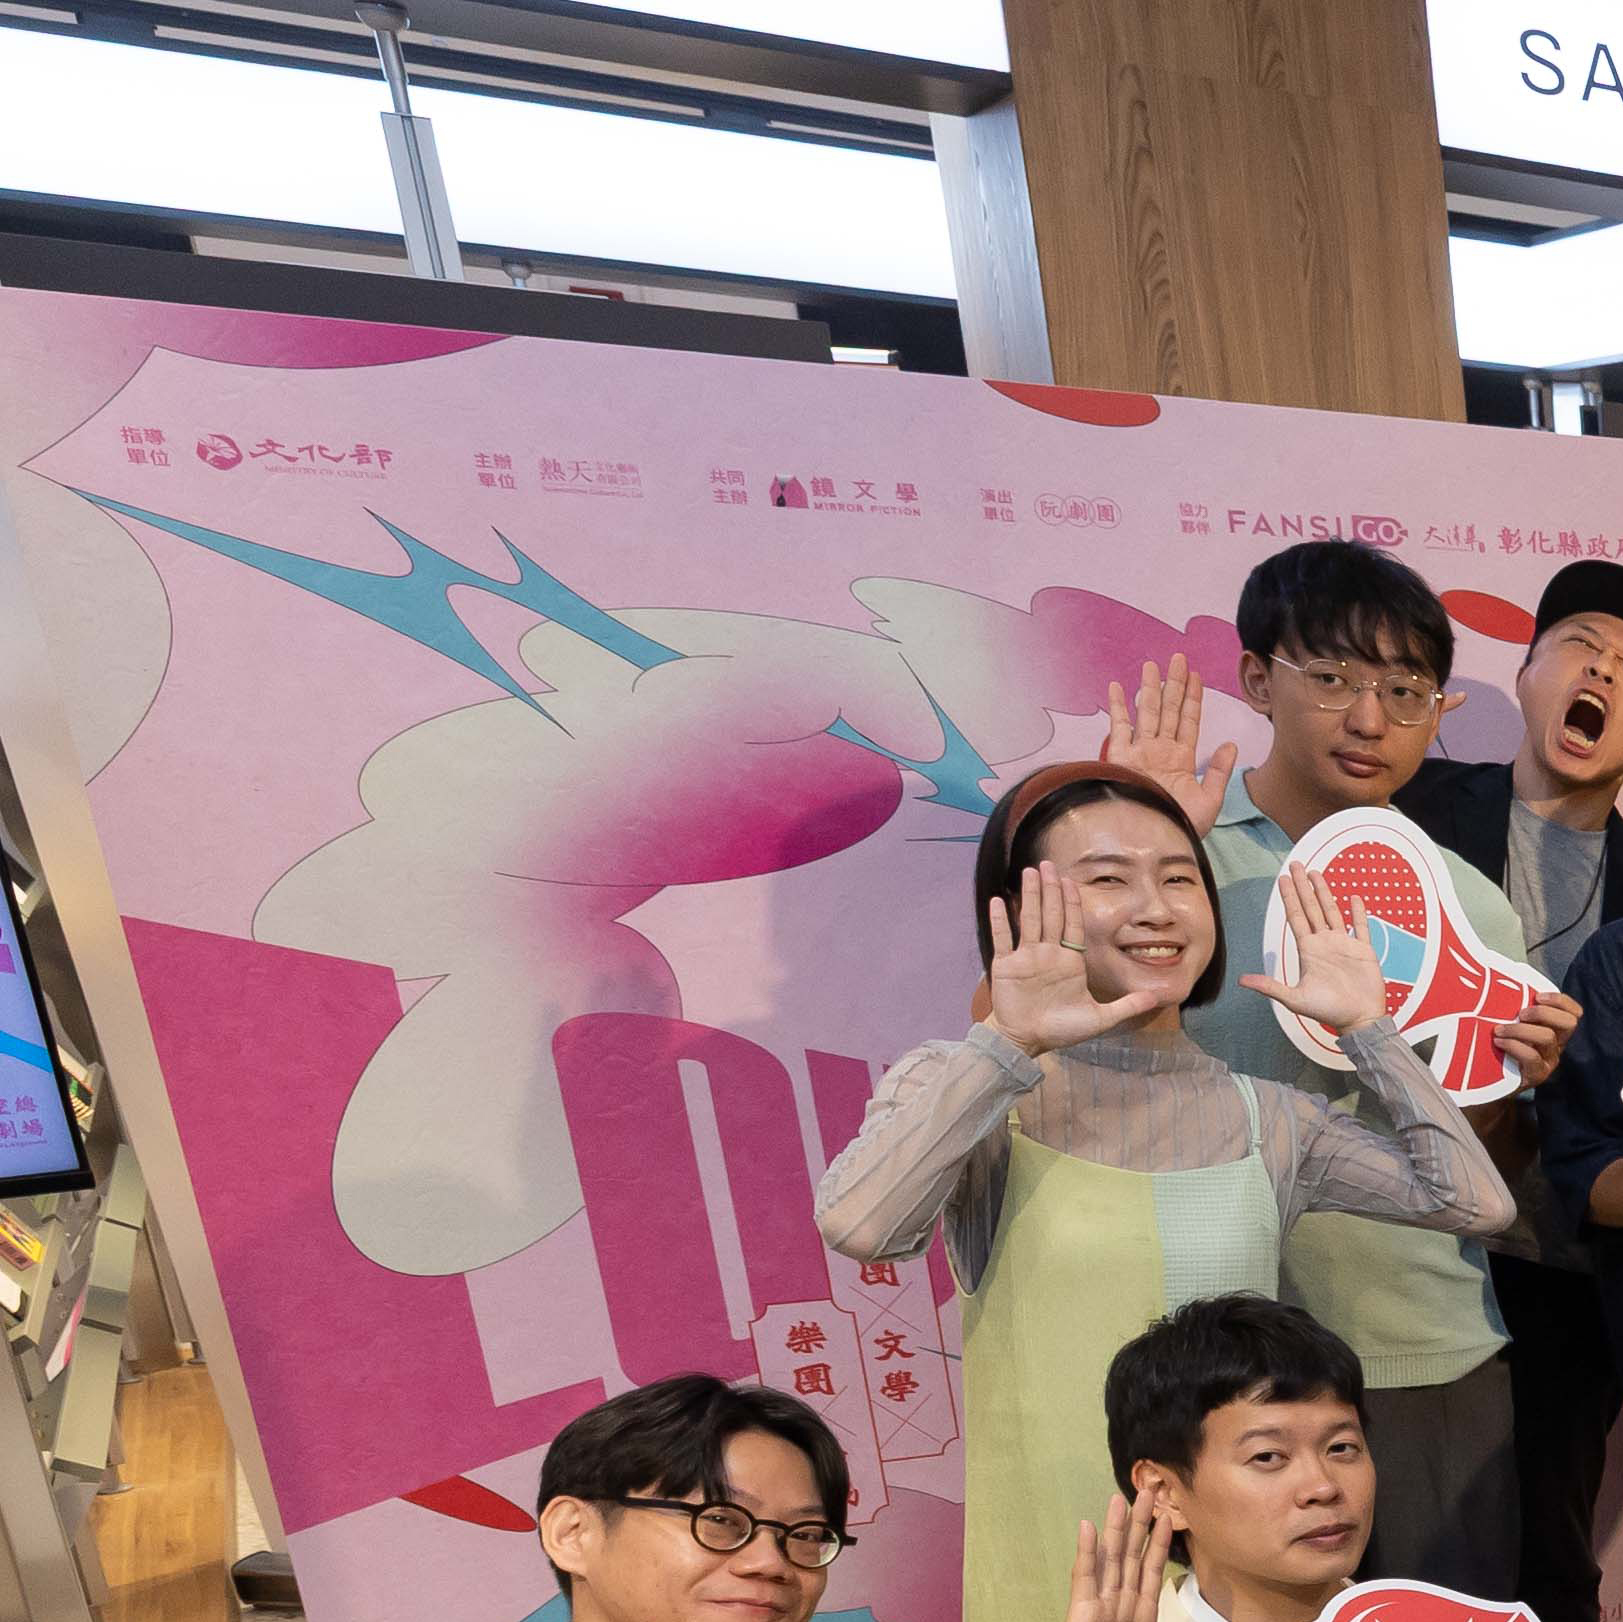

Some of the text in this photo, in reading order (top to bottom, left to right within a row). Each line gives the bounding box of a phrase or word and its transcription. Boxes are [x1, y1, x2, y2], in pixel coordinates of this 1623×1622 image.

[120, 425, 166, 446] 指導
[126, 446, 171, 467] 單位
[249, 438, 393, 470] 文化部
[478, 472, 517, 490] 單位
[709, 468, 745, 486] 共同
[809, 476, 919, 503] 鏡文學
[1039, 500, 1116, 524] 阮劇團
[1227, 510, 1397, 543] FANSI GO
[785, 1320, 837, 1396] 樂團
[873, 1328, 921, 1402] 文學
